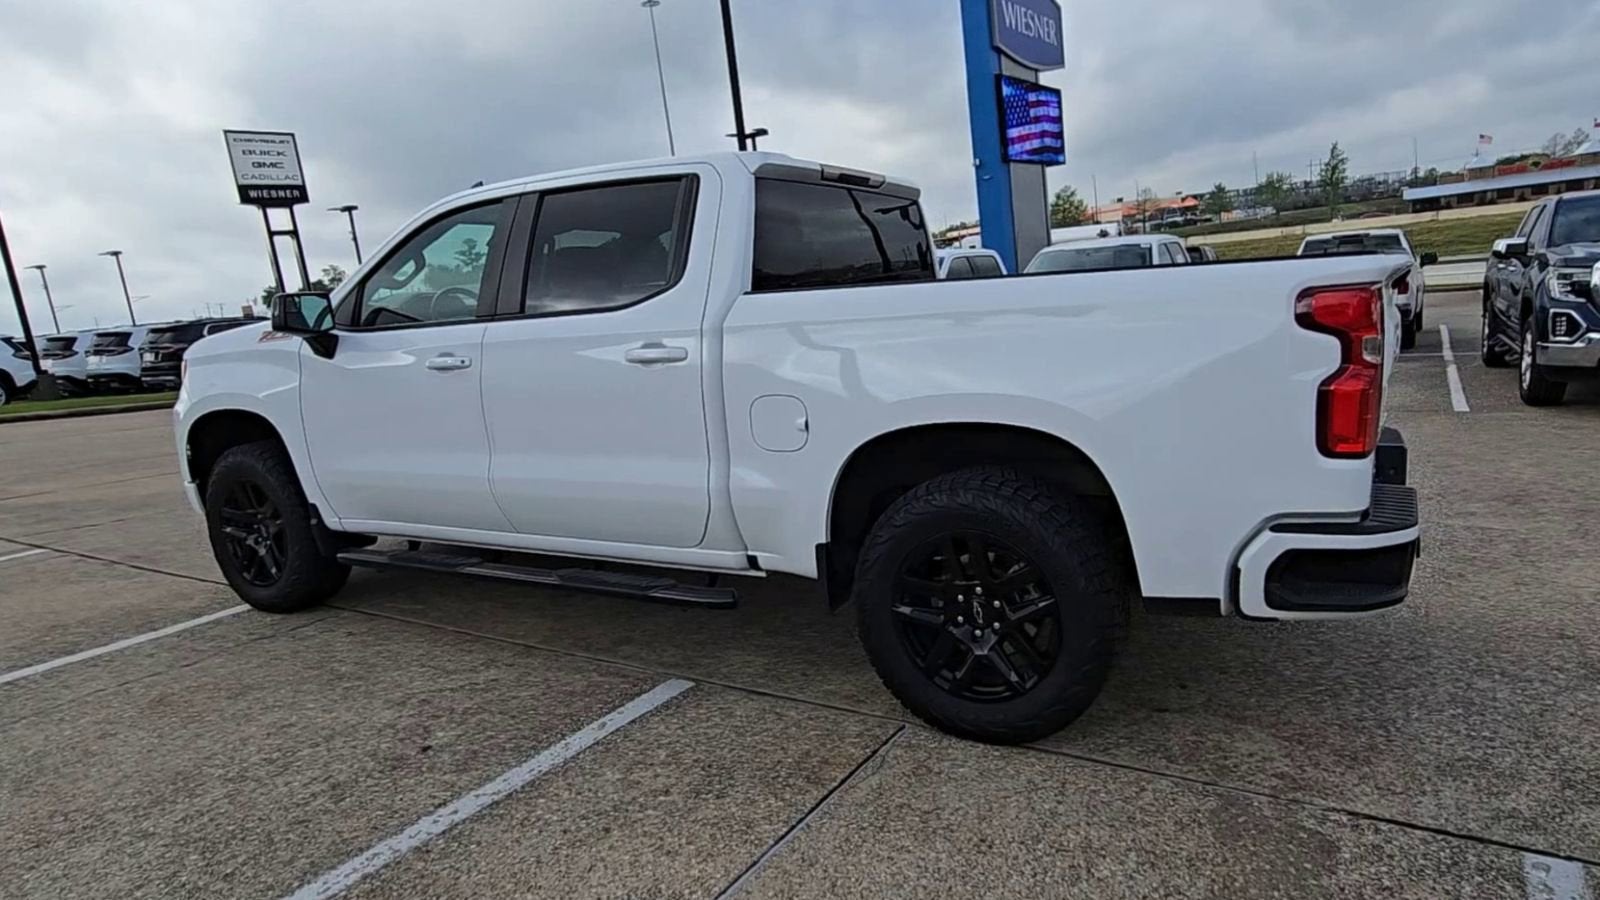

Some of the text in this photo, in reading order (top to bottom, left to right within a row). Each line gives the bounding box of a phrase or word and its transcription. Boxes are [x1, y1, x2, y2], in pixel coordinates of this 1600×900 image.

[1001, 0, 1058, 47] WIESNER
[232, 137, 290, 145] CHEVROLET
[241, 149, 287, 157] BUICK
[251, 161, 285, 169] GMC
[241, 173, 299, 181] CADILLAC
[247, 189, 300, 198] WIESNER
